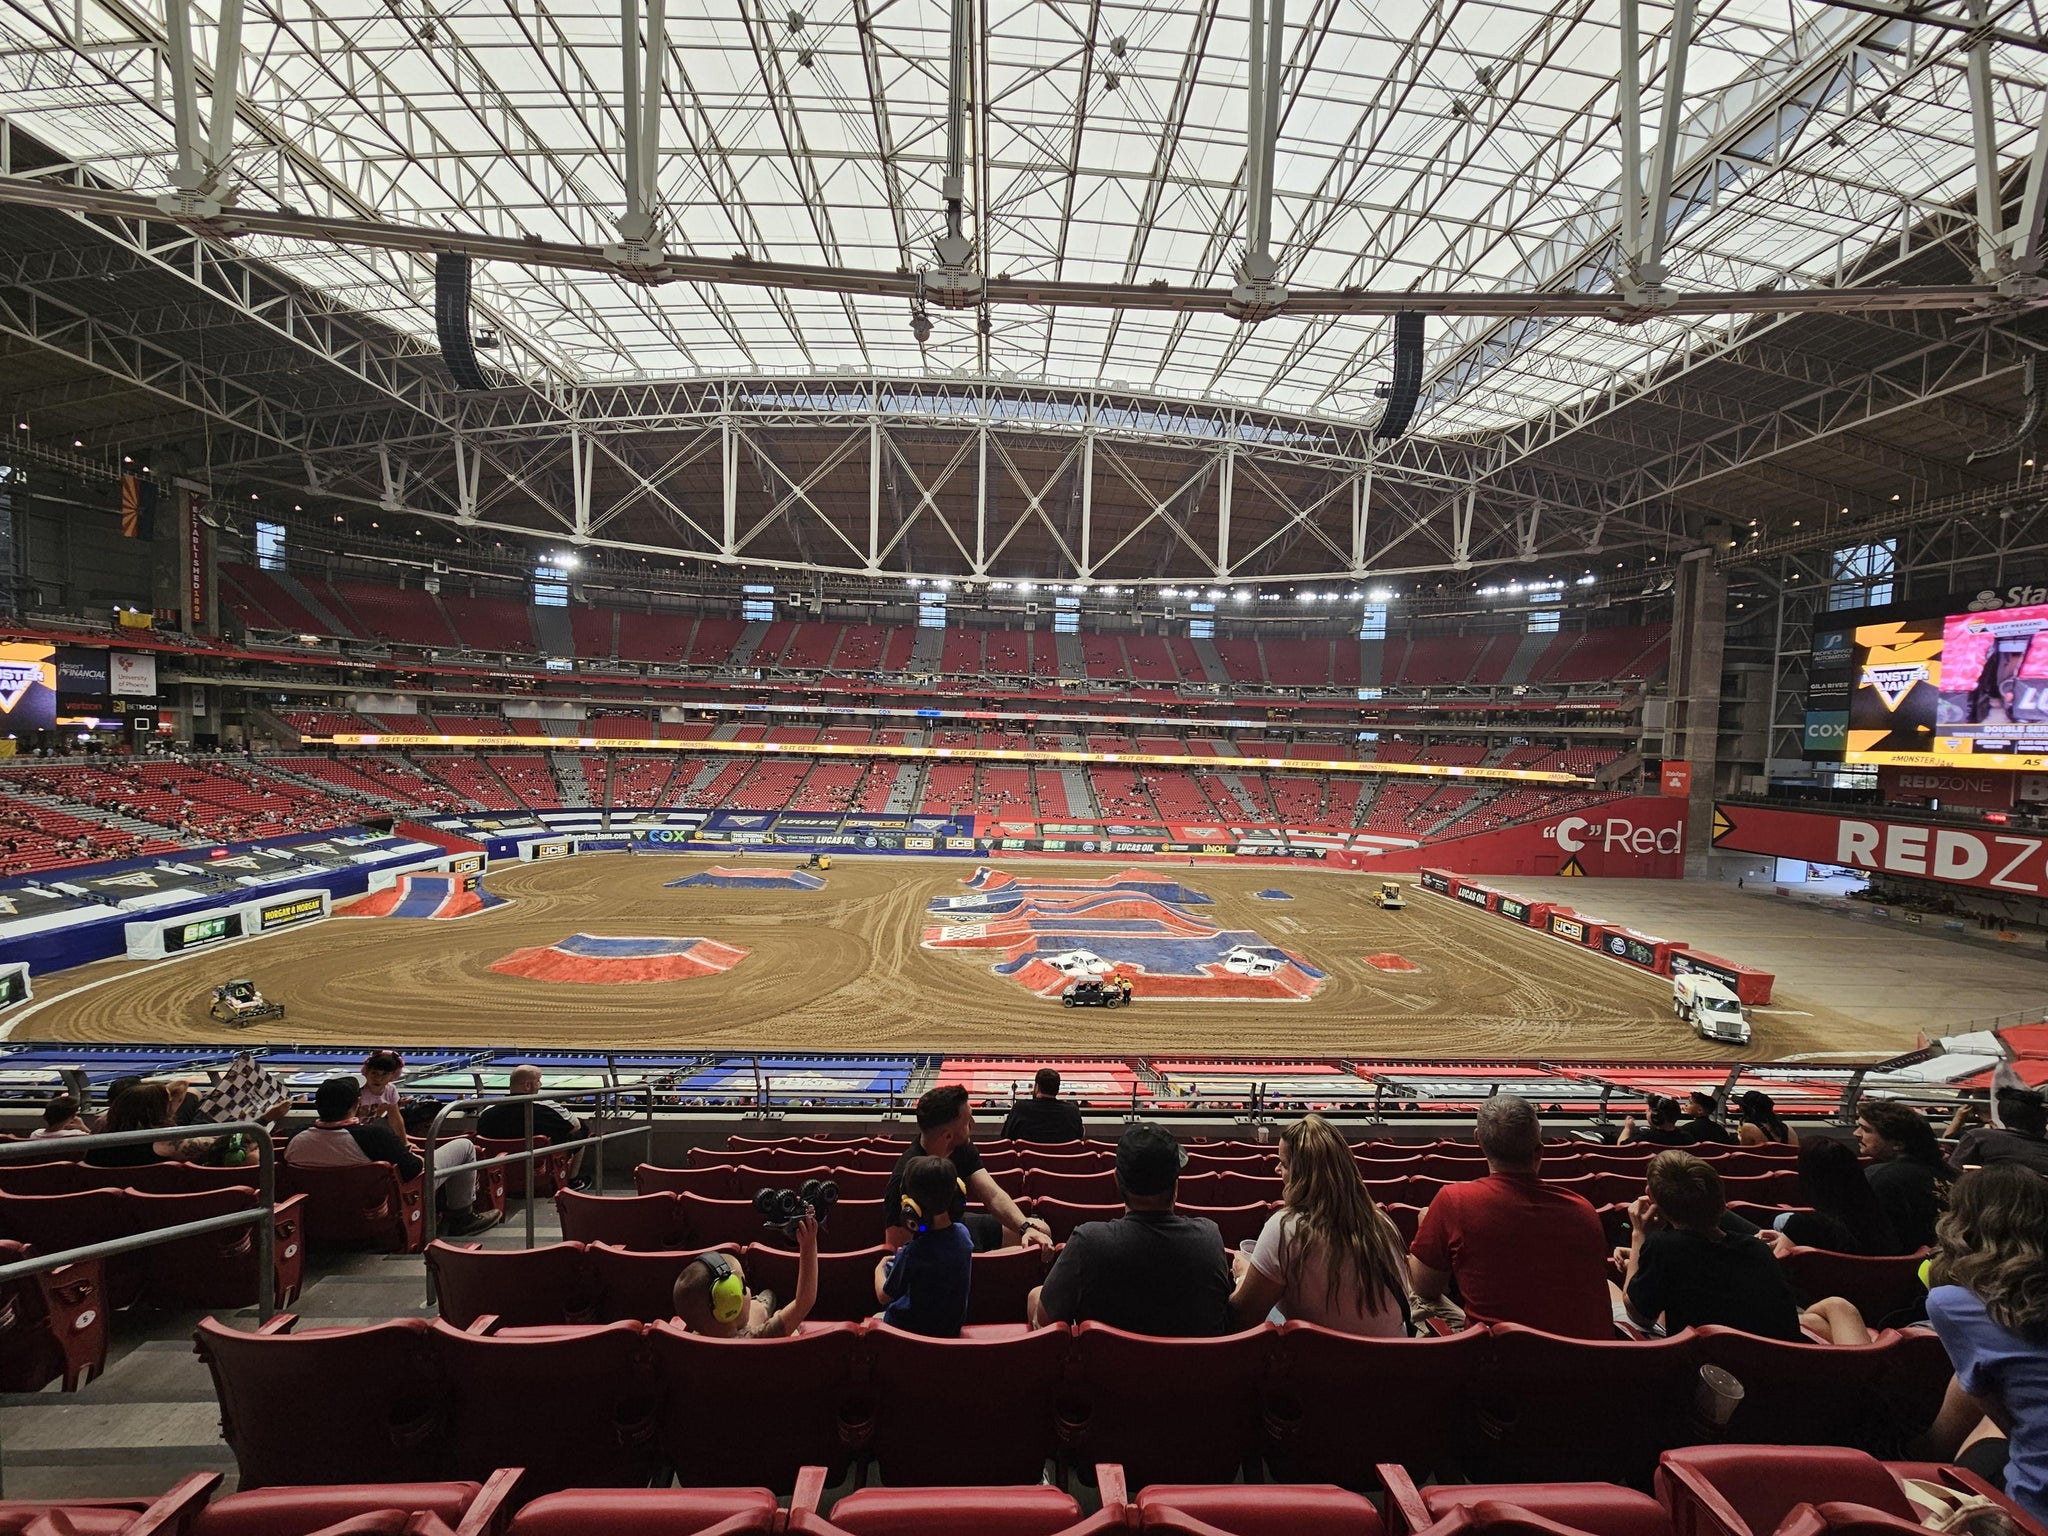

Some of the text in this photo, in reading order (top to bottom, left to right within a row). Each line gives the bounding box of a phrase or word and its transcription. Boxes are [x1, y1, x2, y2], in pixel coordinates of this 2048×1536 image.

[2005, 585, 2048, 607] Sta
[118, 674, 147, 683] University
[1861, 669, 1930, 684] MONSTER
[66, 702, 103, 711] verizon
[127, 703, 158, 711] BETMGM
[1808, 724, 1846, 737] COX
[1984, 725, 2025, 733] DOUBLE
[1900, 774, 1993, 793] REDZONE
[649, 829, 686, 843] COX
[816, 835, 841, 844] LUCAS
[842, 836, 856, 845] OIL
[1604, 817, 1683, 854] Red
[542, 845, 566, 855] JCB
[906, 839, 932, 848] JCB
[948, 839, 973, 848] JCB
[1116, 843, 1155, 852] LUCAS OIL
[1202, 844, 1227, 853] UNOH
[1836, 819, 2048, 892] REDZ
[456, 860, 478, 873] JCB
[1458, 887, 1487, 906] LUCAS OIL
[264, 907, 291, 921] MORGAN
[296, 900, 320, 913] MORGAN
[185, 920, 226, 940] BKT
[1555, 920, 1580, 937] JCB
